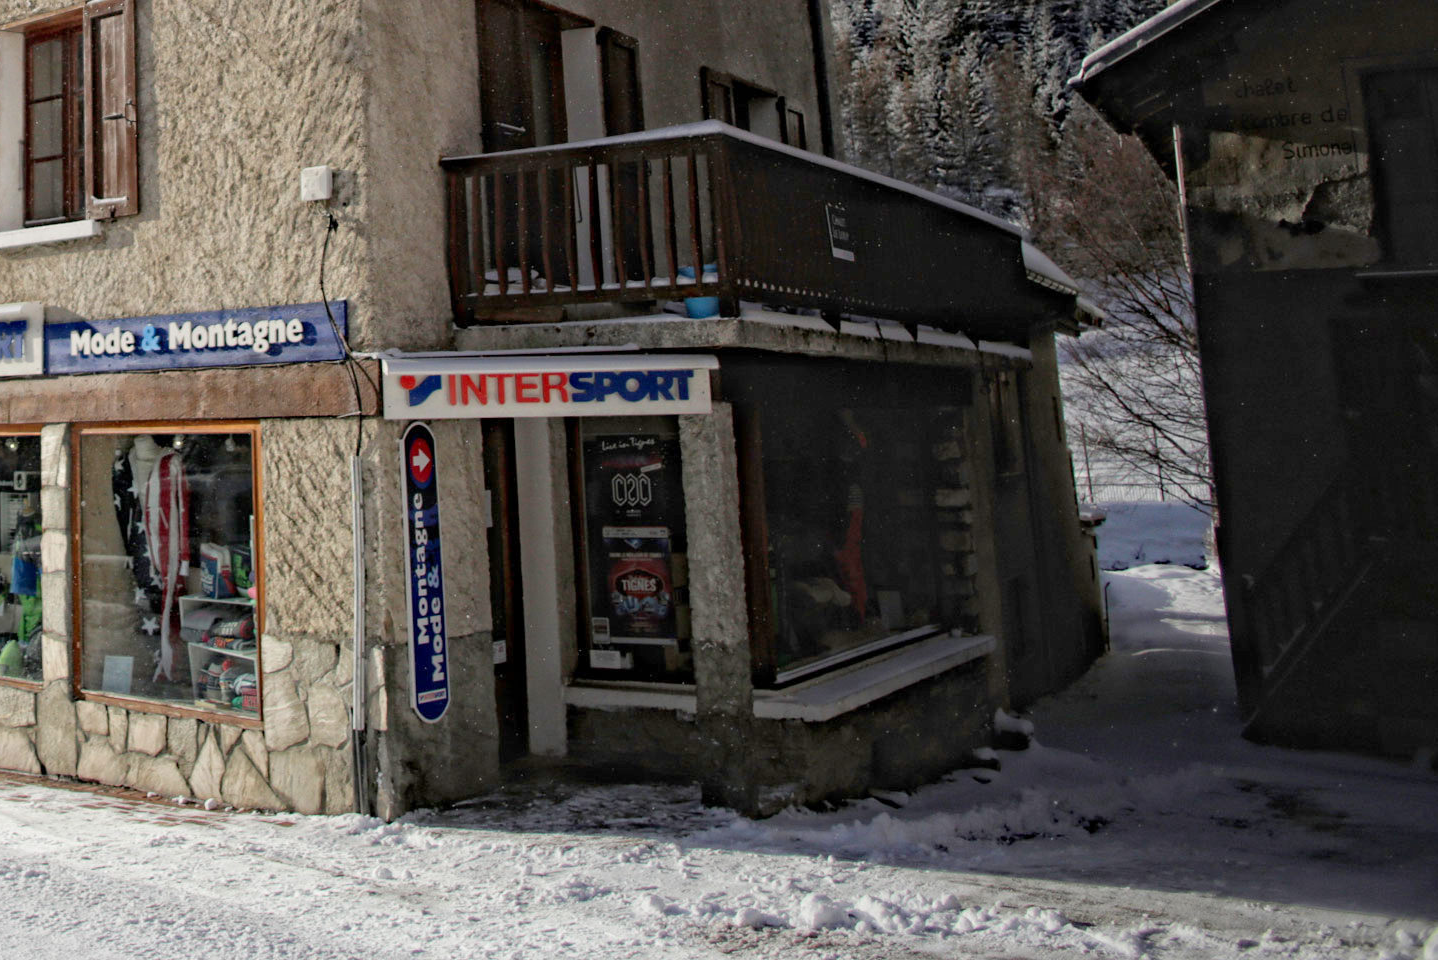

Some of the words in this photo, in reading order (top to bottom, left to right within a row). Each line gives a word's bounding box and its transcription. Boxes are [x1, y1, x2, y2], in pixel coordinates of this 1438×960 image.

[1320, 104, 1348, 123] de
[1282, 141, 1353, 160] Simone
[70, 326, 136, 356] Mode
[141, 324, 162, 352] &
[168, 318, 304, 353] Montagne
[448, 369, 695, 406] INTERSPORT
[413, 492, 430, 645] Montagne
[427, 564, 440, 589] &
[620, 578, 657, 592] TIGNES
[429, 596, 445, 682] Mode
